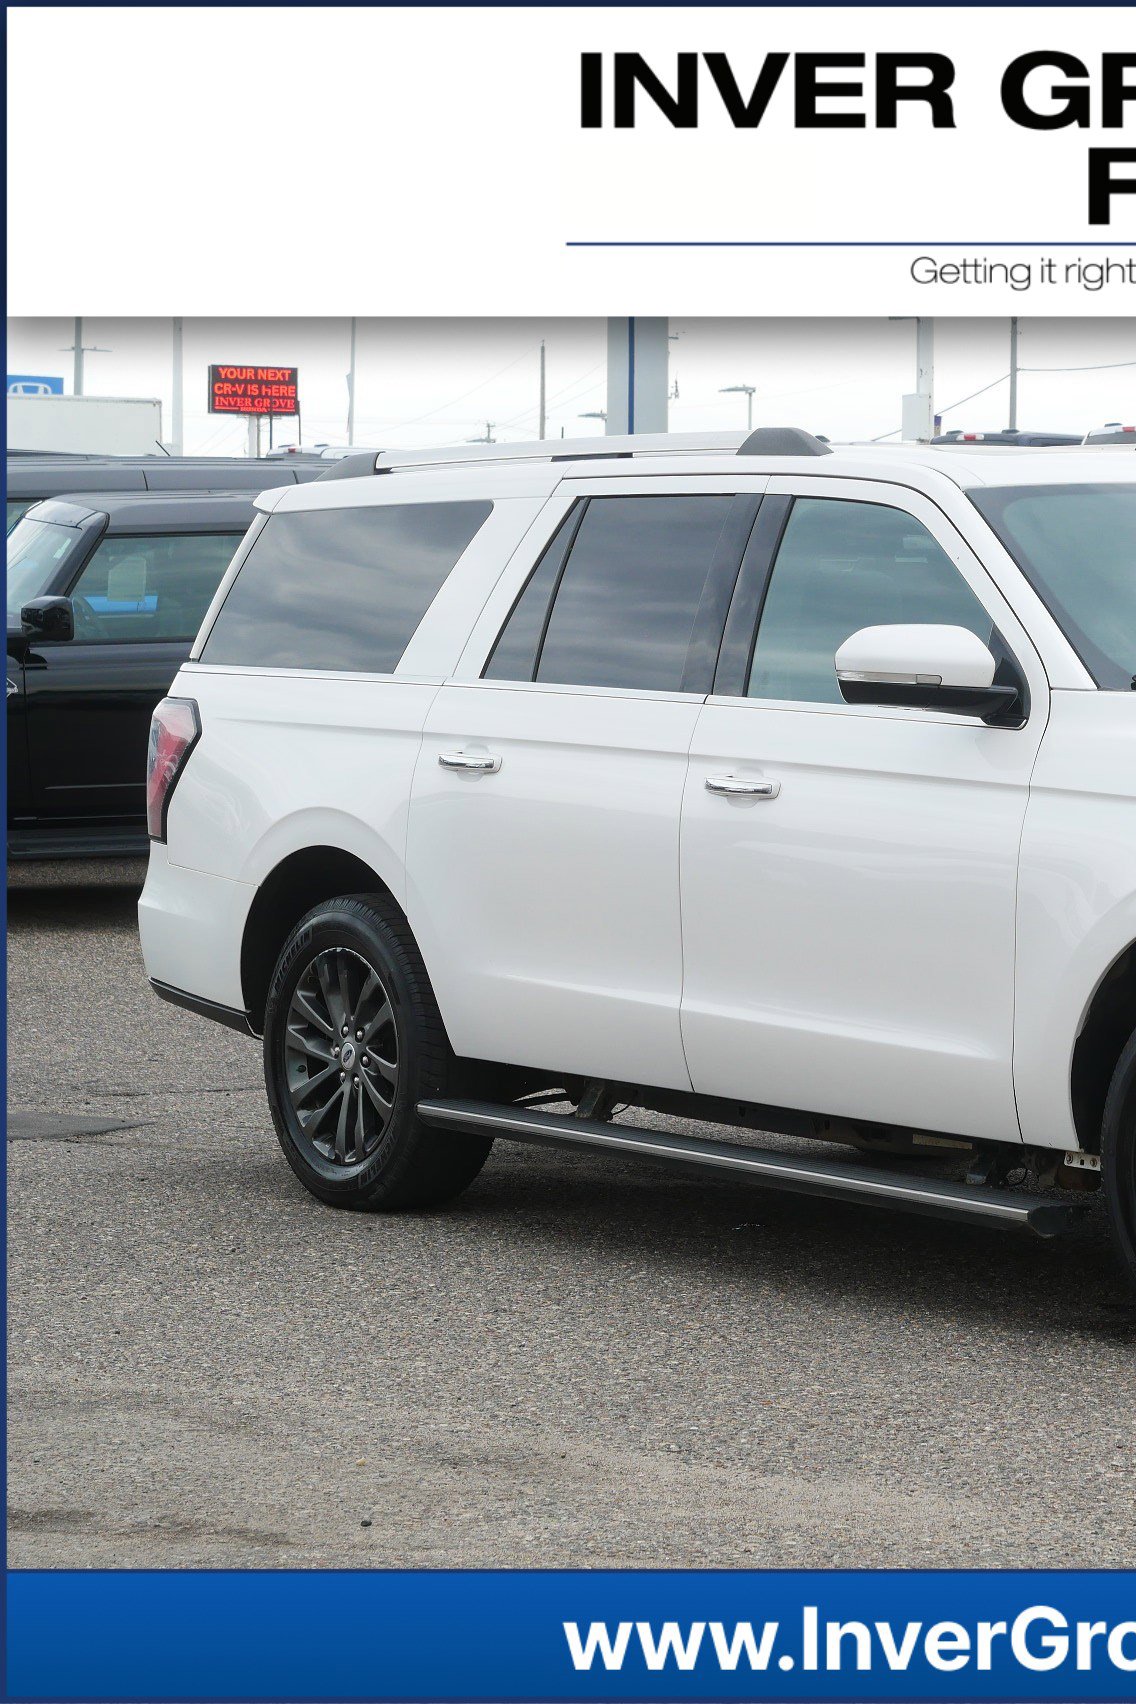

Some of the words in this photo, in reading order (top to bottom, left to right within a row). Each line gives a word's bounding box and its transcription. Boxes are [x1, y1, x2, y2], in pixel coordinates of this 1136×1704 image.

[218, 367, 254, 379] YOUR
[258, 369, 291, 381] NEXT
[214, 383, 244, 395] CR-V
[247, 384, 259, 395] IS
[262, 384, 296, 396] HERE
[215, 396, 252, 406] INVER
[254, 398, 295, 408] GROVE
